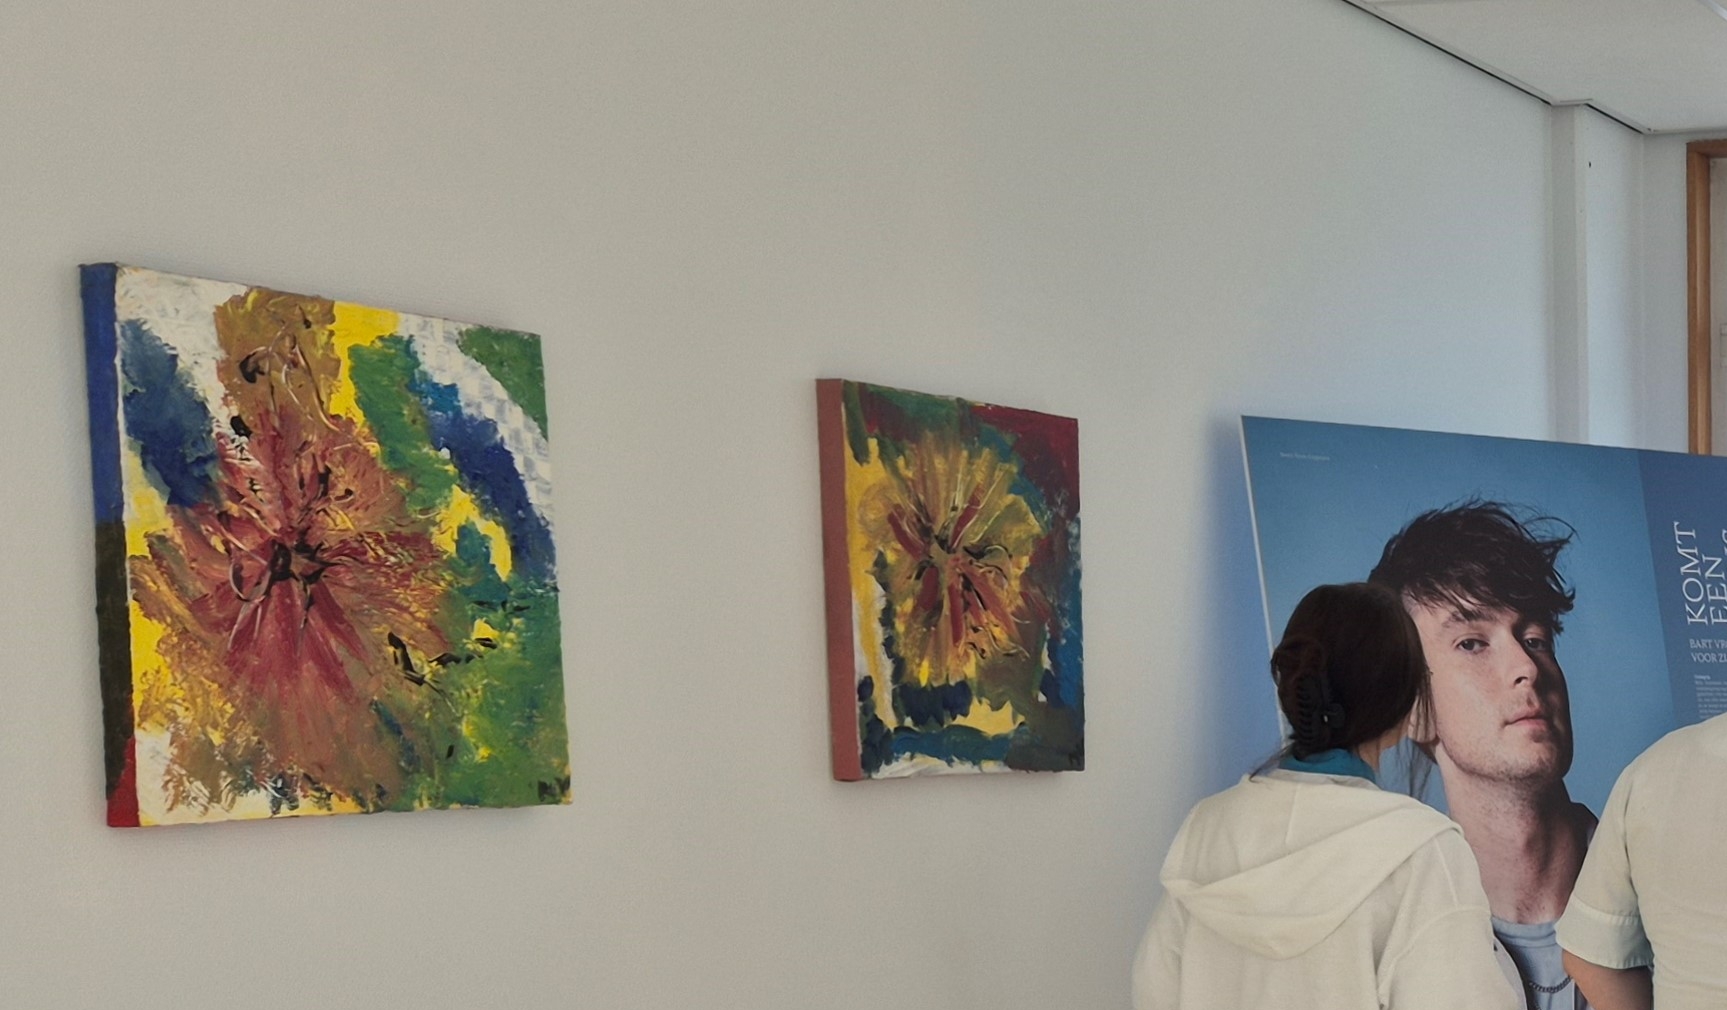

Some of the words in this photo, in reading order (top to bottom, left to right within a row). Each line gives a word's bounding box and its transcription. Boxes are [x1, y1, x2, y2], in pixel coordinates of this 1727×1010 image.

[1673, 521, 1708, 626] KOMT
[1689, 638, 1713, 649] BART
[1690, 652, 1718, 663] VOOR
